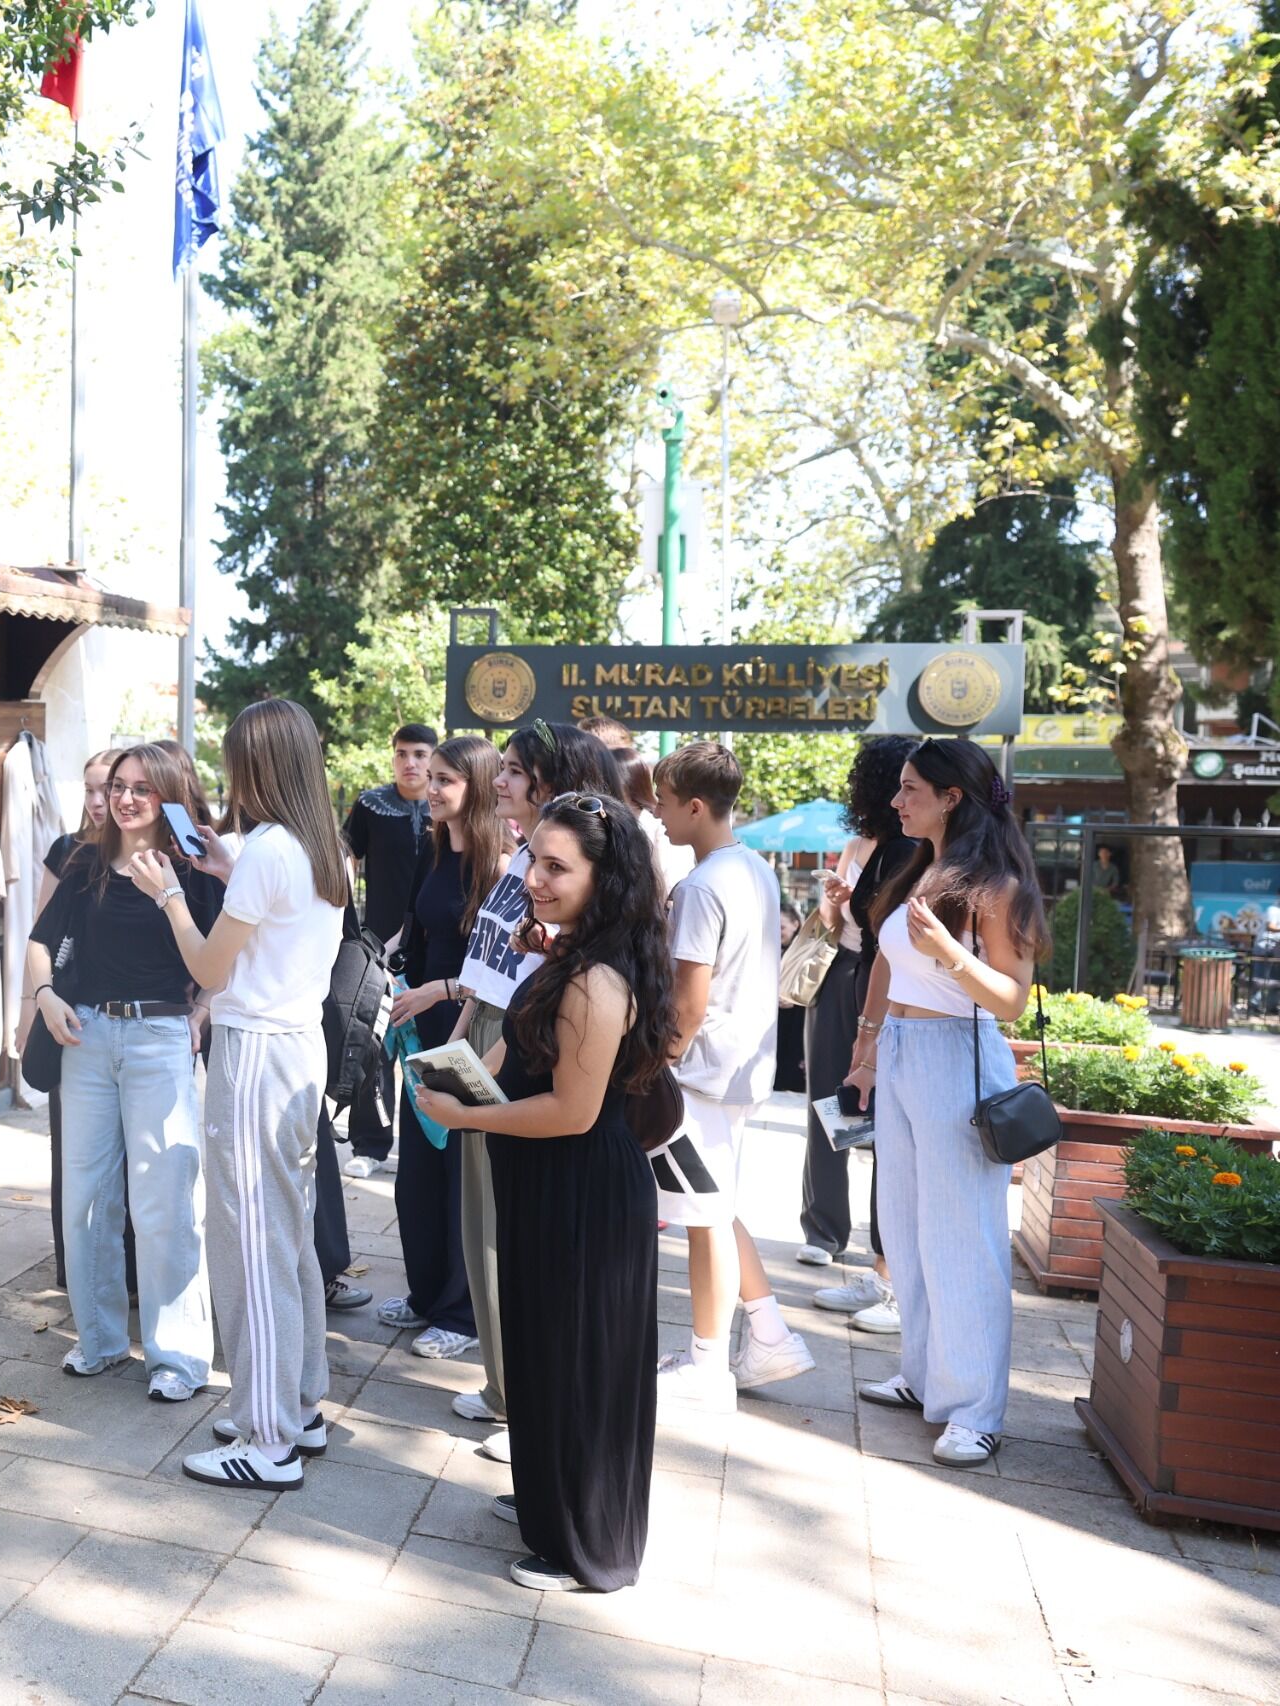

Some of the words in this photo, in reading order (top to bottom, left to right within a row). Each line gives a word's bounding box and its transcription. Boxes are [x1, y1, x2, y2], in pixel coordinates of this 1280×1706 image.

[562, 663, 586, 686] II.
[594, 663, 713, 686] MURAD
[722, 656, 890, 688] KÜLLİYESİ
[571, 695, 691, 718] SULTAN
[699, 689, 878, 720] TÜRBELERİ
